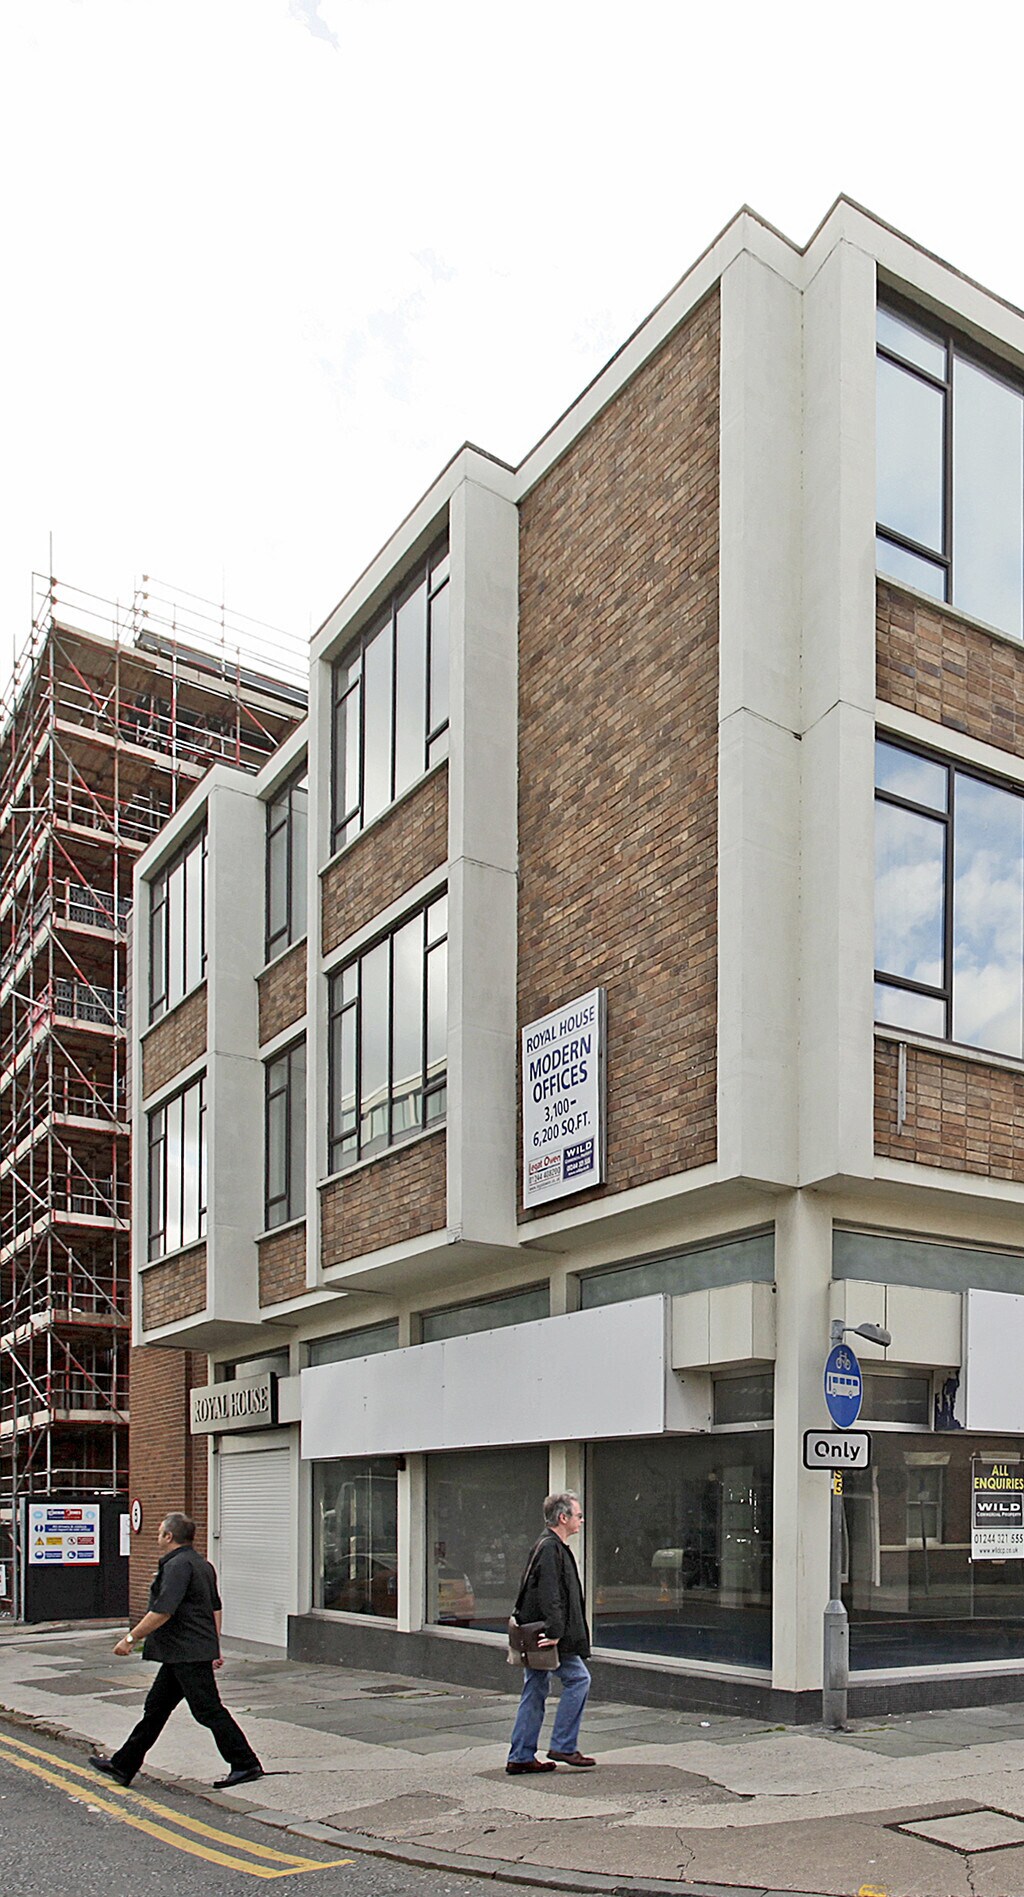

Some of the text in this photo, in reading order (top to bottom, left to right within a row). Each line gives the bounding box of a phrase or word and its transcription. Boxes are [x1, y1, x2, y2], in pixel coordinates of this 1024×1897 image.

[526, 1005, 595, 1053] ROYAL HOUSE
[529, 1033, 592, 1081] MODERN
[532, 1060, 588, 1103] OFFICES
[532, 1124, 559, 1147] 6,200
[566, 1141, 592, 1158] WILD
[194, 1386, 269, 1422] ROYAL HOUSE
[814, 1440, 861, 1462] Only
[991, 1464, 1009, 1477] ALL
[973, 1477, 1024, 1490] ENQUIRIES
[977, 1502, 1021, 1512] WILD
[974, 1533, 1024, 1544] 01244 321 555
